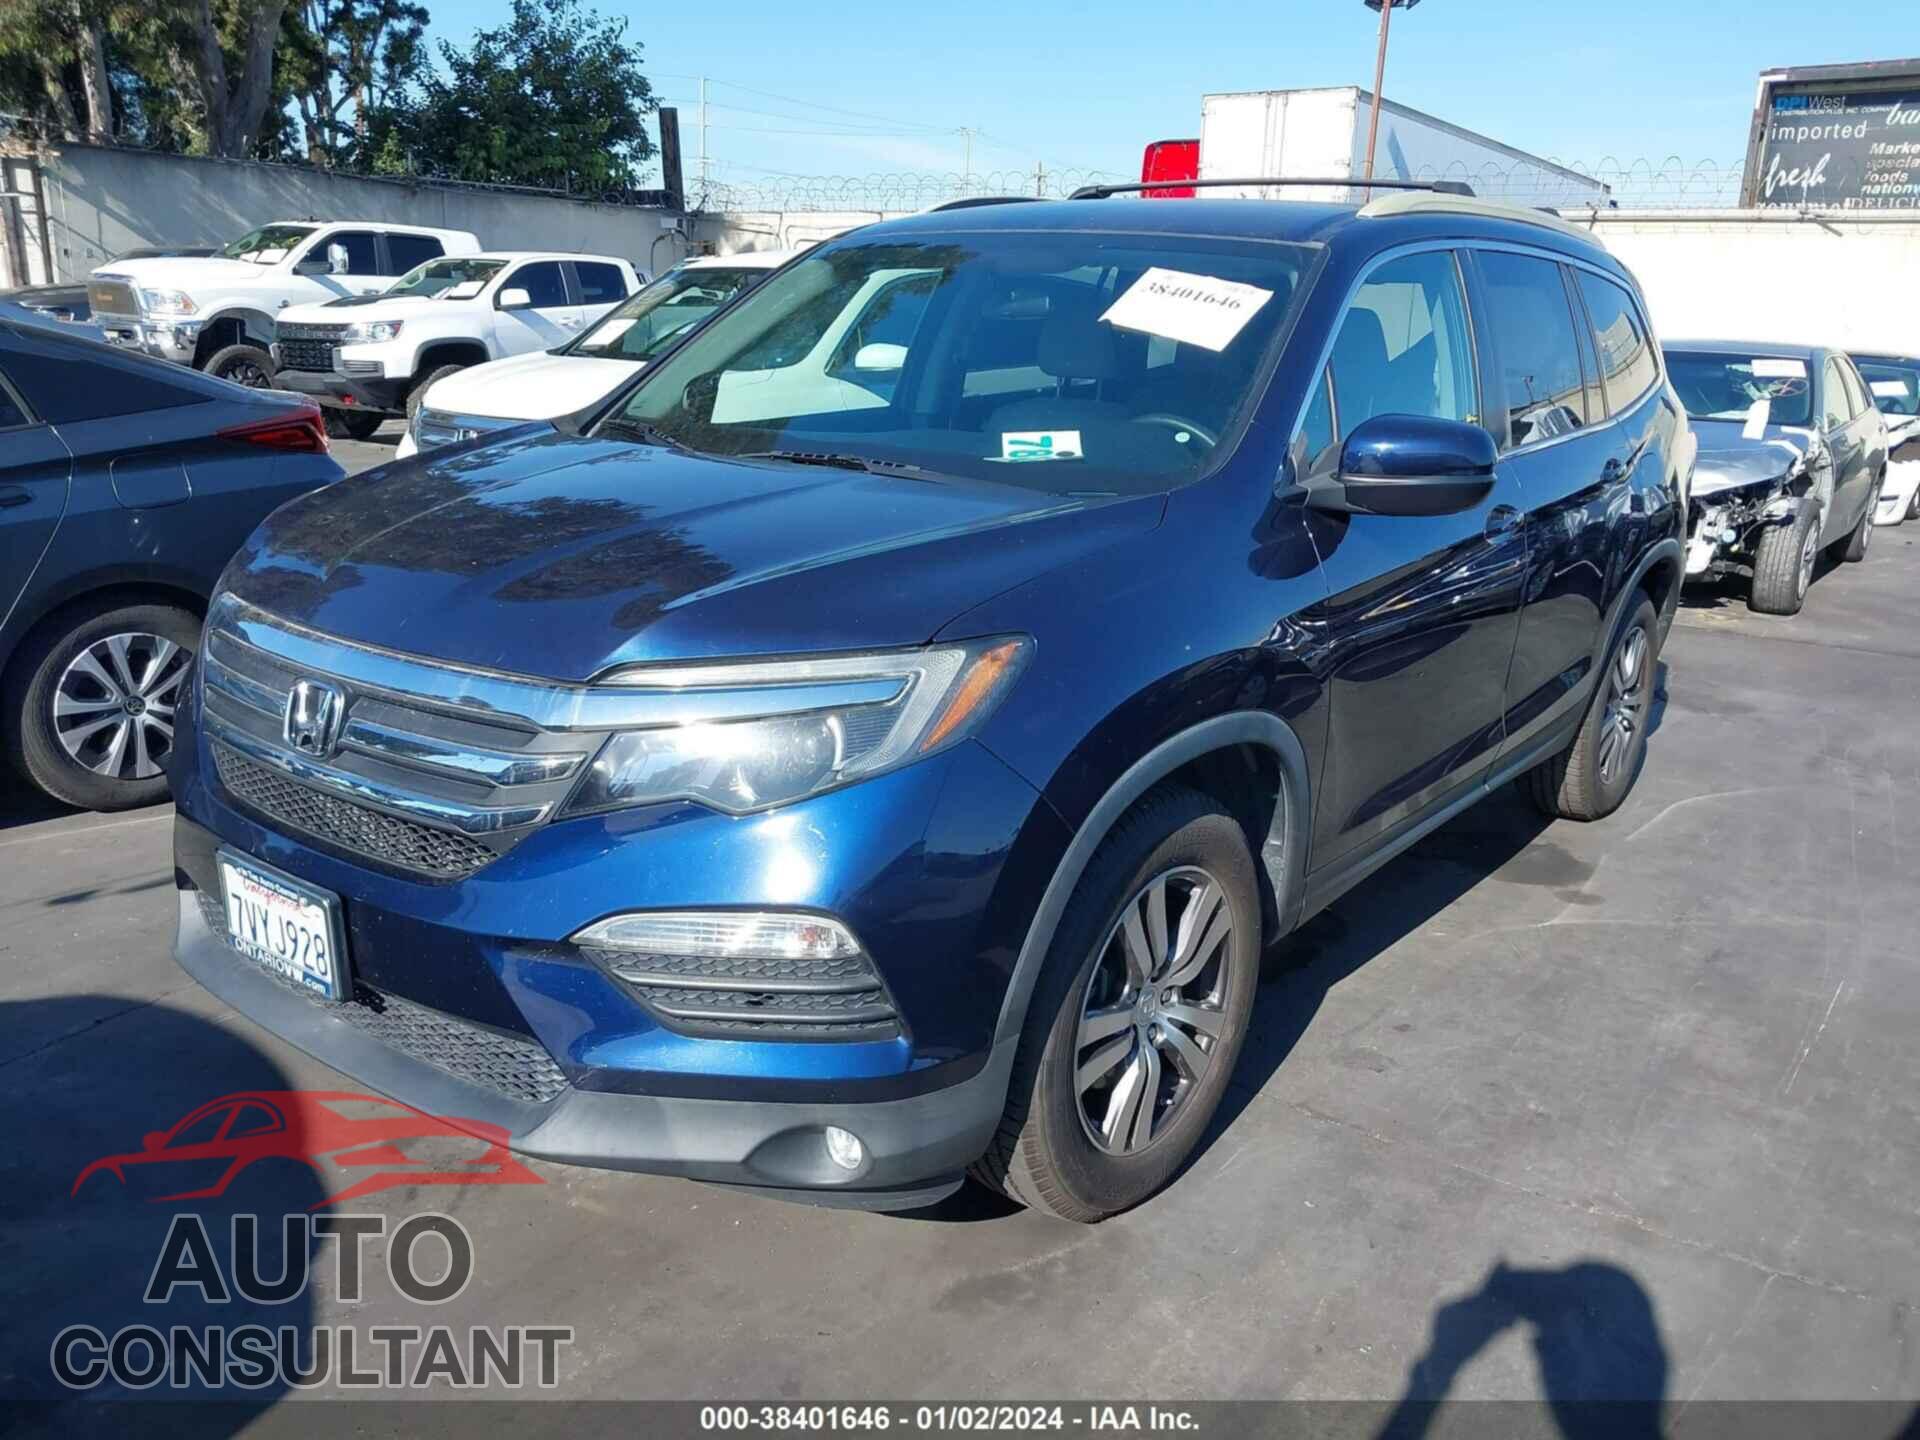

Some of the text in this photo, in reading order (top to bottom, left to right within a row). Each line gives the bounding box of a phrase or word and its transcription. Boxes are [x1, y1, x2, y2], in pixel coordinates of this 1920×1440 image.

[1808, 95, 1846, 109] West
[1771, 120, 1867, 143] imported
[1760, 152, 1831, 198] fresh
[1863, 170, 1908, 182] foods
[1143, 281, 1241, 309] 38401646
